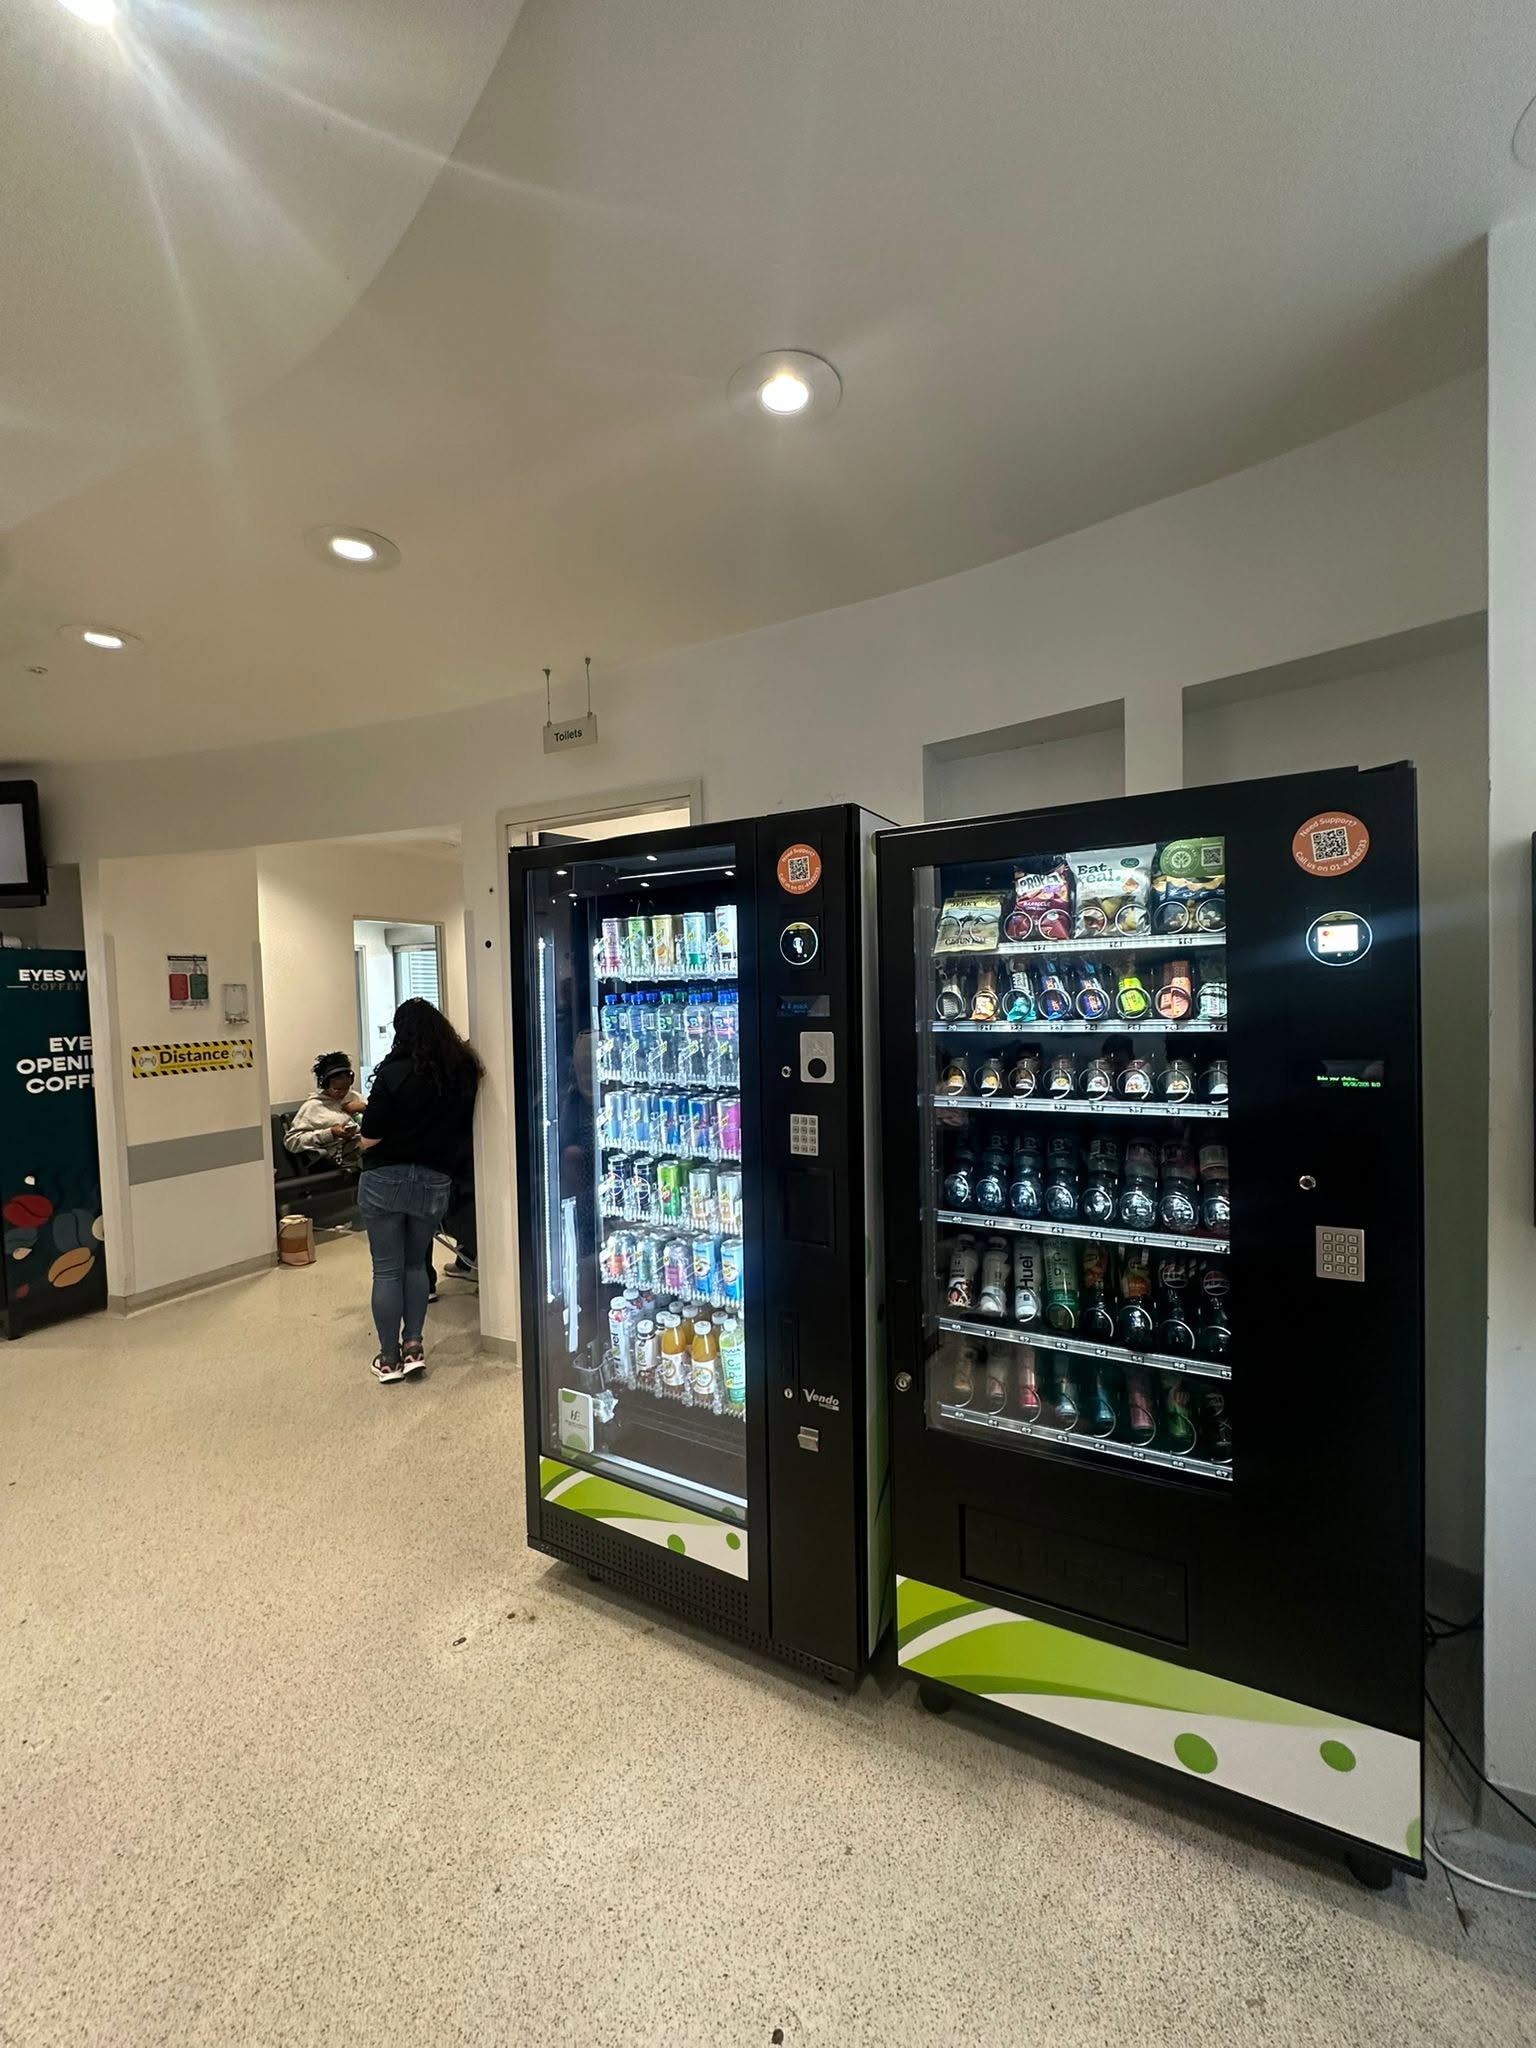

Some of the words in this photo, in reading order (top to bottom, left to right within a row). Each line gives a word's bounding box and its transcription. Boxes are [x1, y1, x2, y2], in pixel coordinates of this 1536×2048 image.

[554, 729, 583, 742] Toilets
[1300, 821, 1319, 837] Need
[1320, 817, 1357, 827] Support?
[1296, 851, 1307, 864] Call
[1077, 863, 1107, 875] Eat
[18, 969, 66, 982] EYES
[16, 1054, 93, 1075] OPENI
[160, 1049, 230, 1064] Distance
[25, 1073, 94, 1094] COFF
[1020, 1255, 1034, 1290] Huel
[802, 1388, 840, 1406] Vendo
